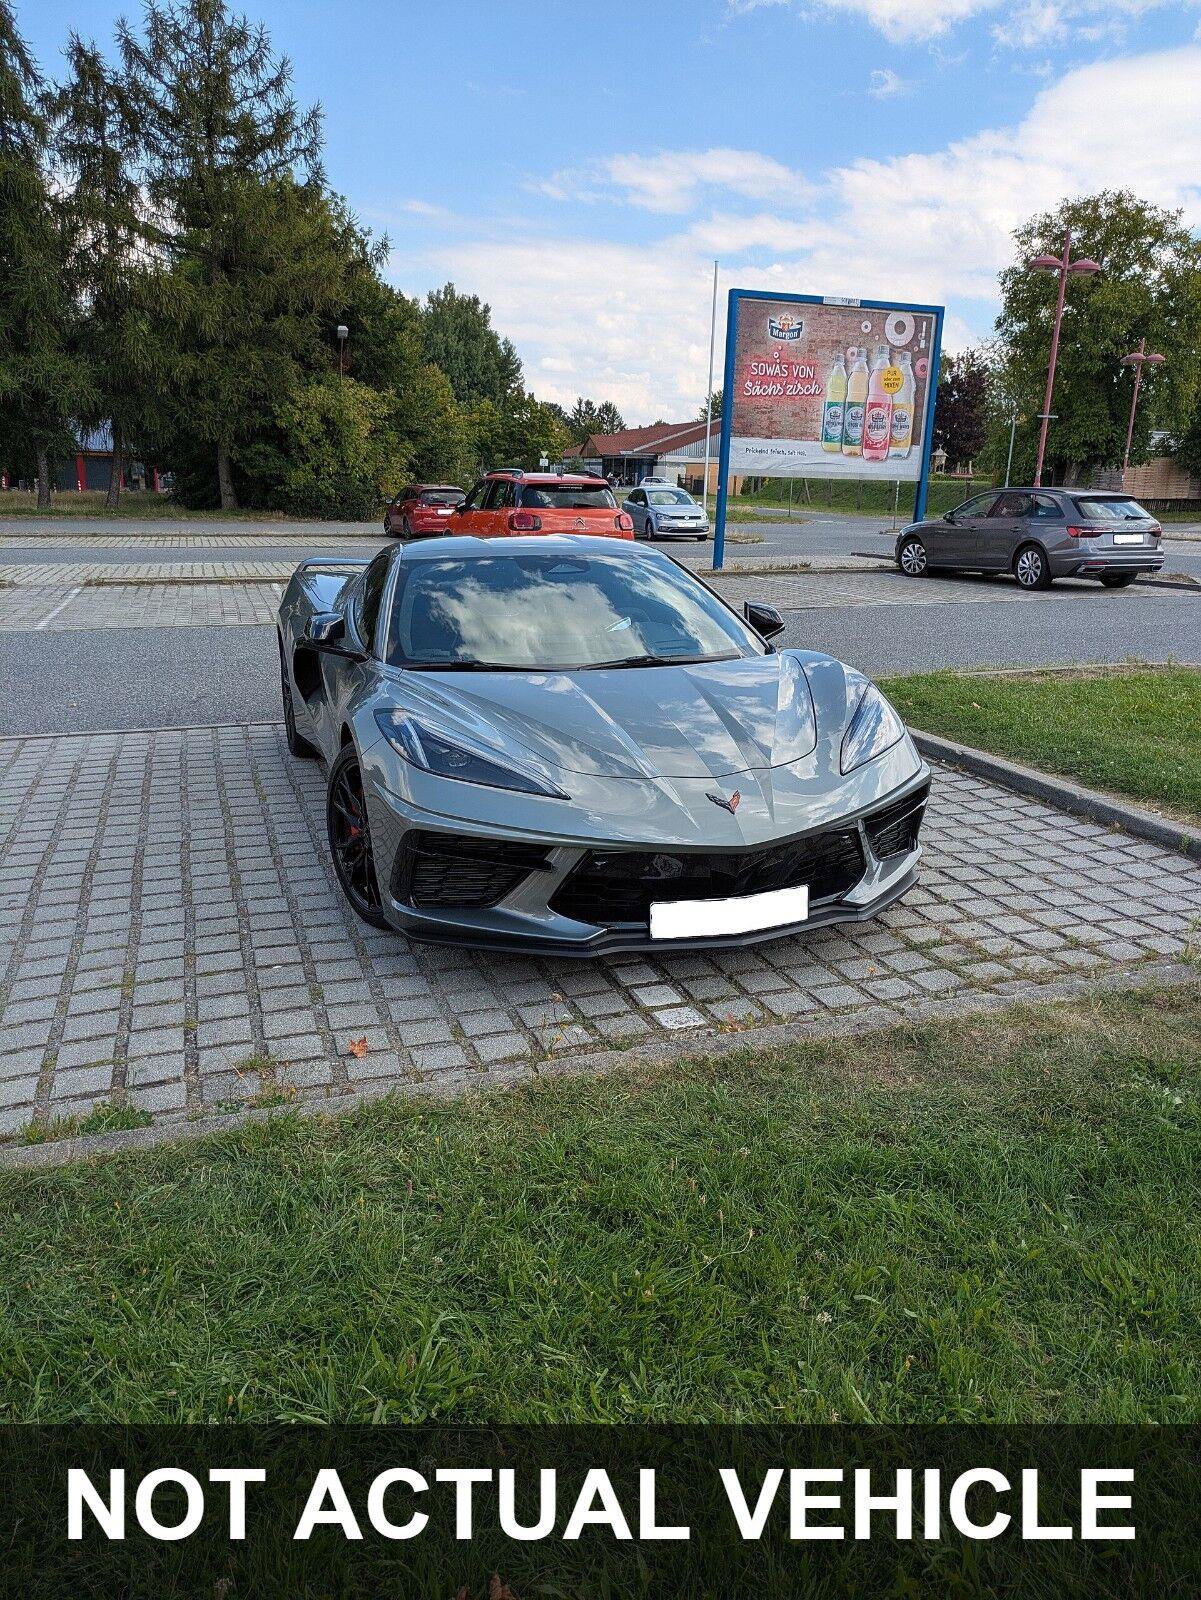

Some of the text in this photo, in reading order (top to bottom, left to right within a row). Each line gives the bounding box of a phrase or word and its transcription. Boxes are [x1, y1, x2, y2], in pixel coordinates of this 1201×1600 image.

[772, 329, 799, 340] Margon
[751, 362, 814, 379] SOWAS VON
